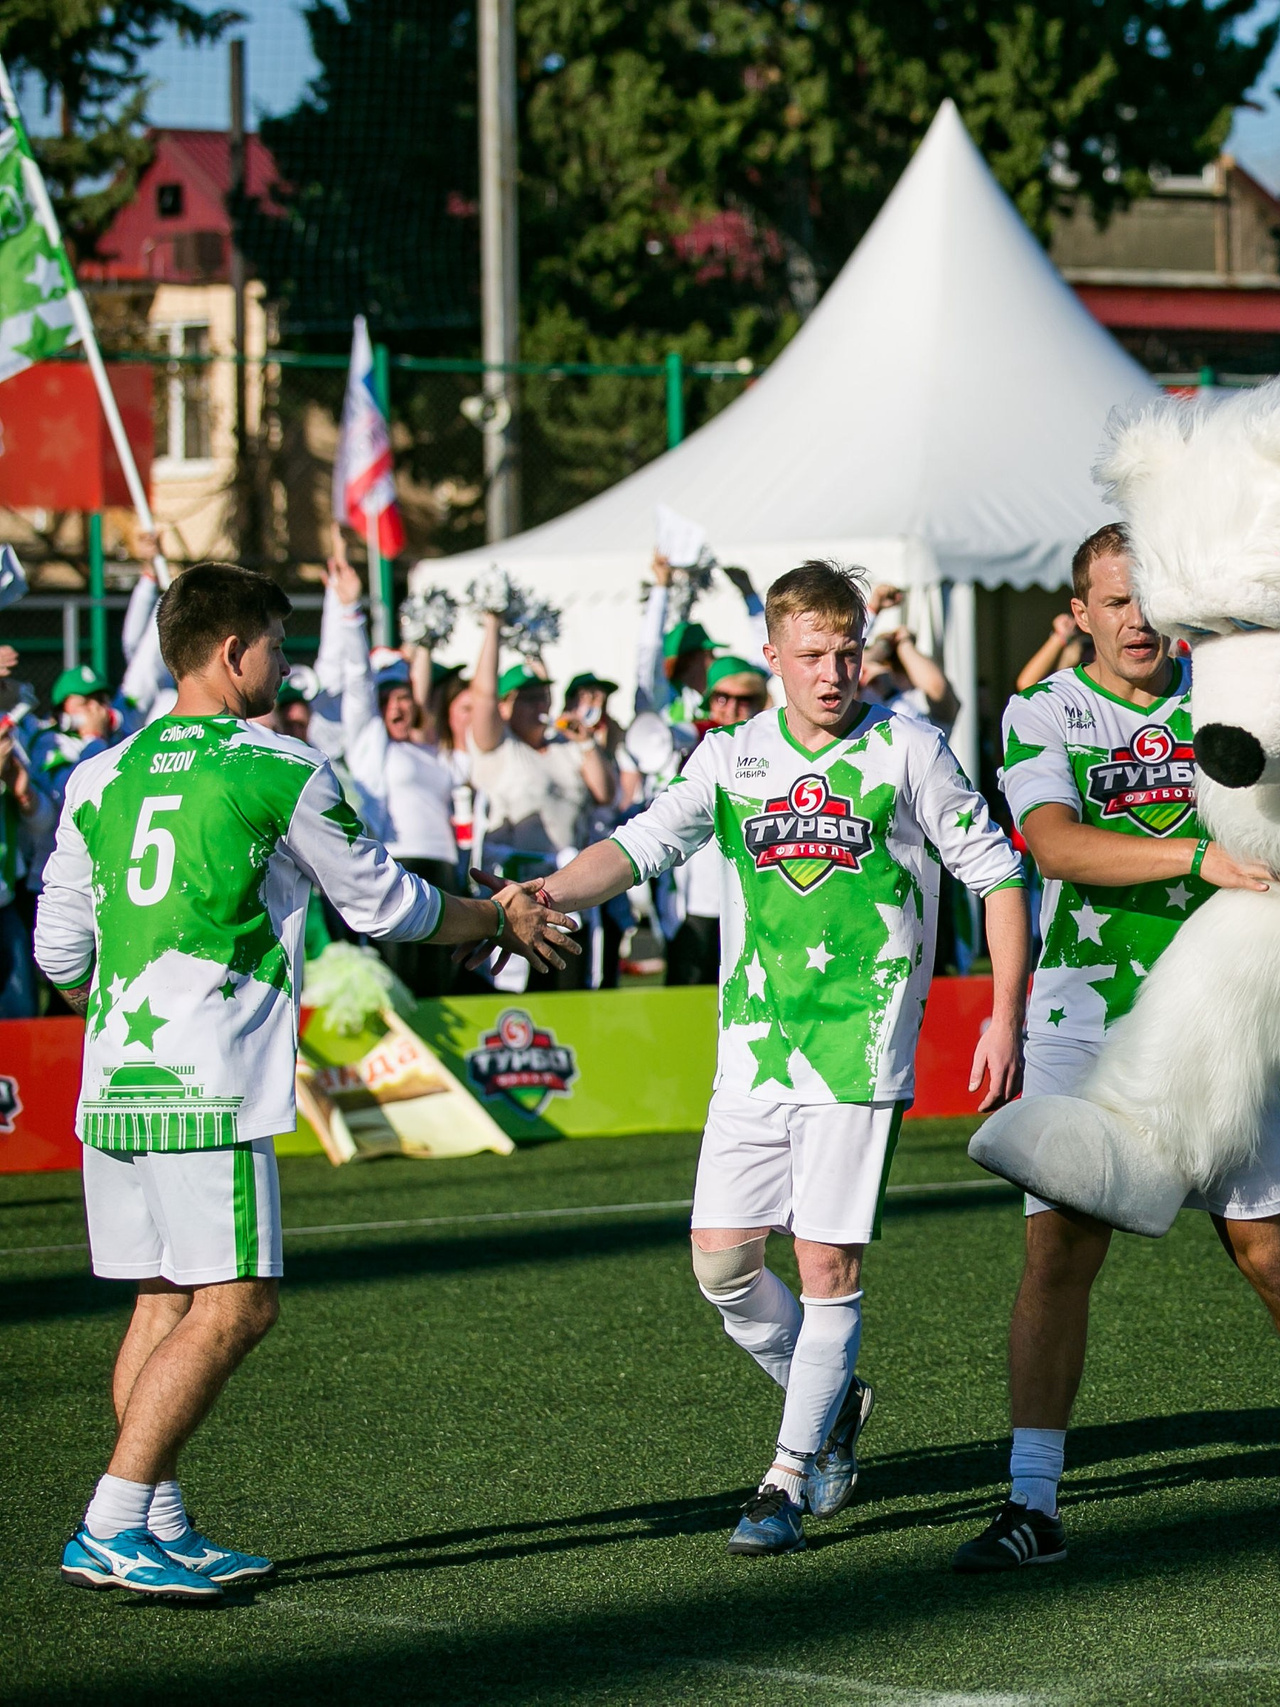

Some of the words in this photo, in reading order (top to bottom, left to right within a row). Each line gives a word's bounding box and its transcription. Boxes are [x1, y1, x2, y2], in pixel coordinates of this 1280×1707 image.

[159, 724, 206, 743] СИБИРЬ
[149, 750, 197, 774] SIZOV
[734, 769, 767, 779] СИБИРЬ
[1097, 761, 1197, 790] ТУРБ
[750, 816, 865, 844] ТУРБО
[126, 794, 184, 907] 5
[774, 844, 840, 857] ФУТБОЛ
